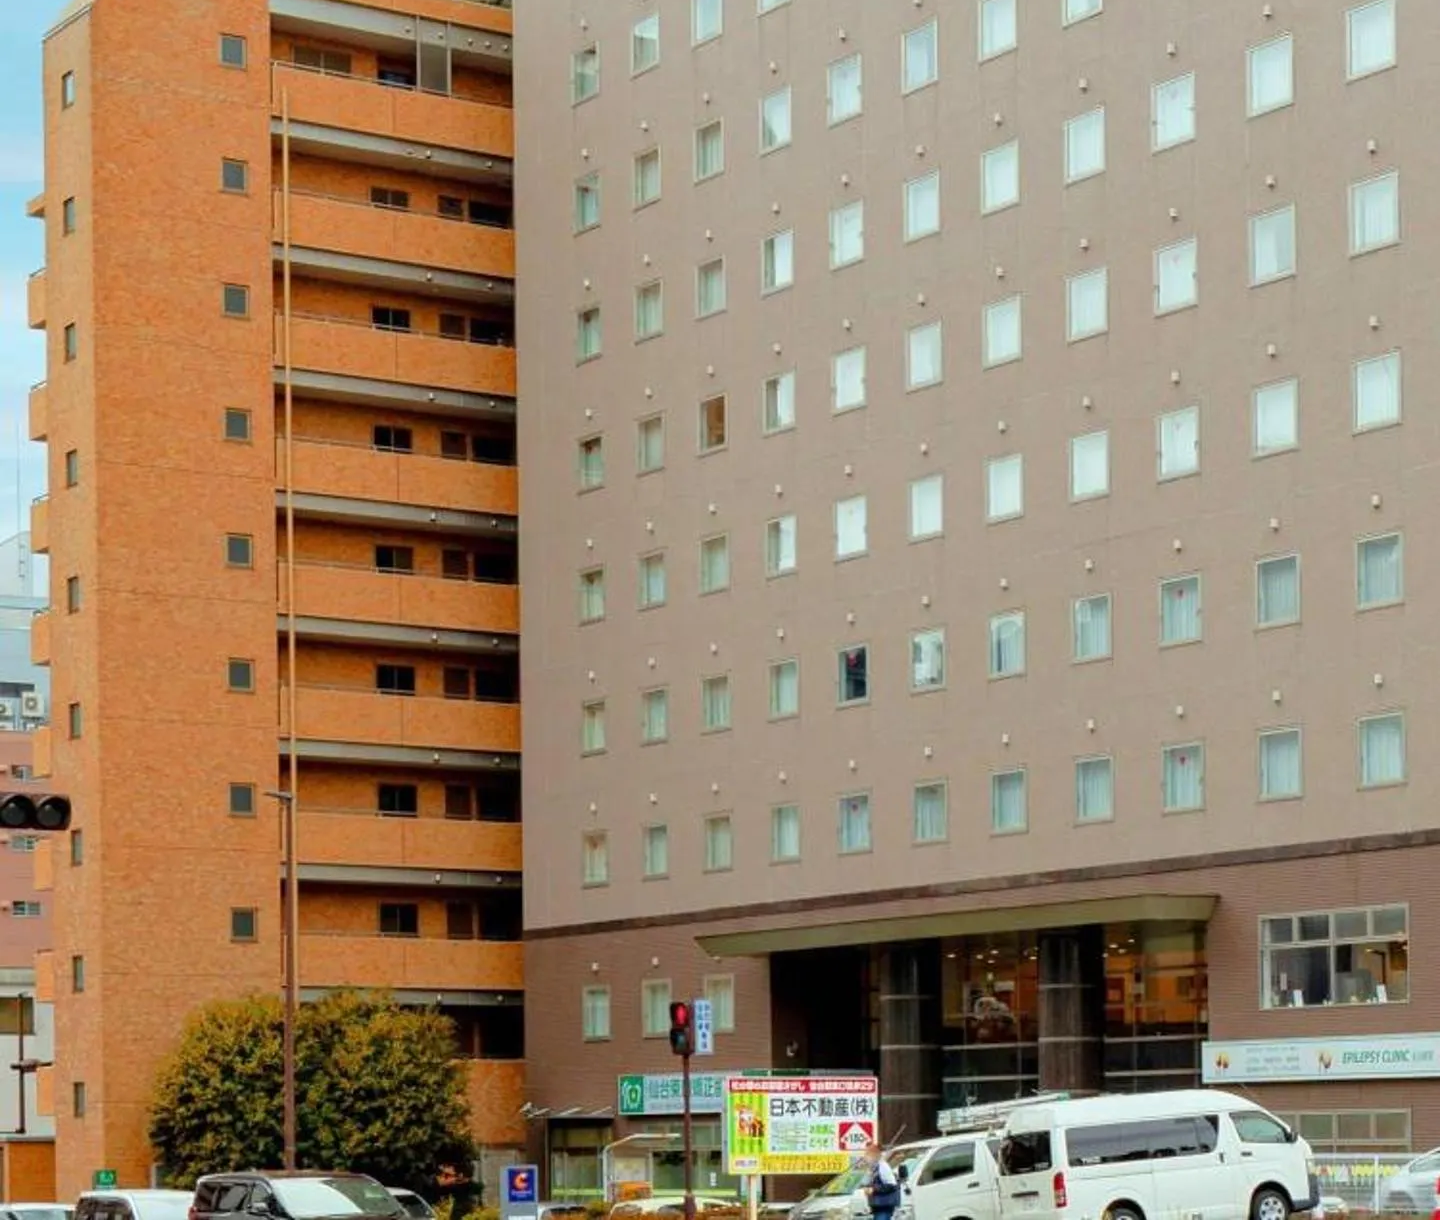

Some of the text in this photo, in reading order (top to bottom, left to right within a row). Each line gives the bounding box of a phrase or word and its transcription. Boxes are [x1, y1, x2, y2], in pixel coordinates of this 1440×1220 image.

[1342, 1050, 1381, 1065] EPILEPSY
[1382, 1048, 1411, 1063] CLINIC
[769, 1097, 875, 1118] 日本不動産(株)
